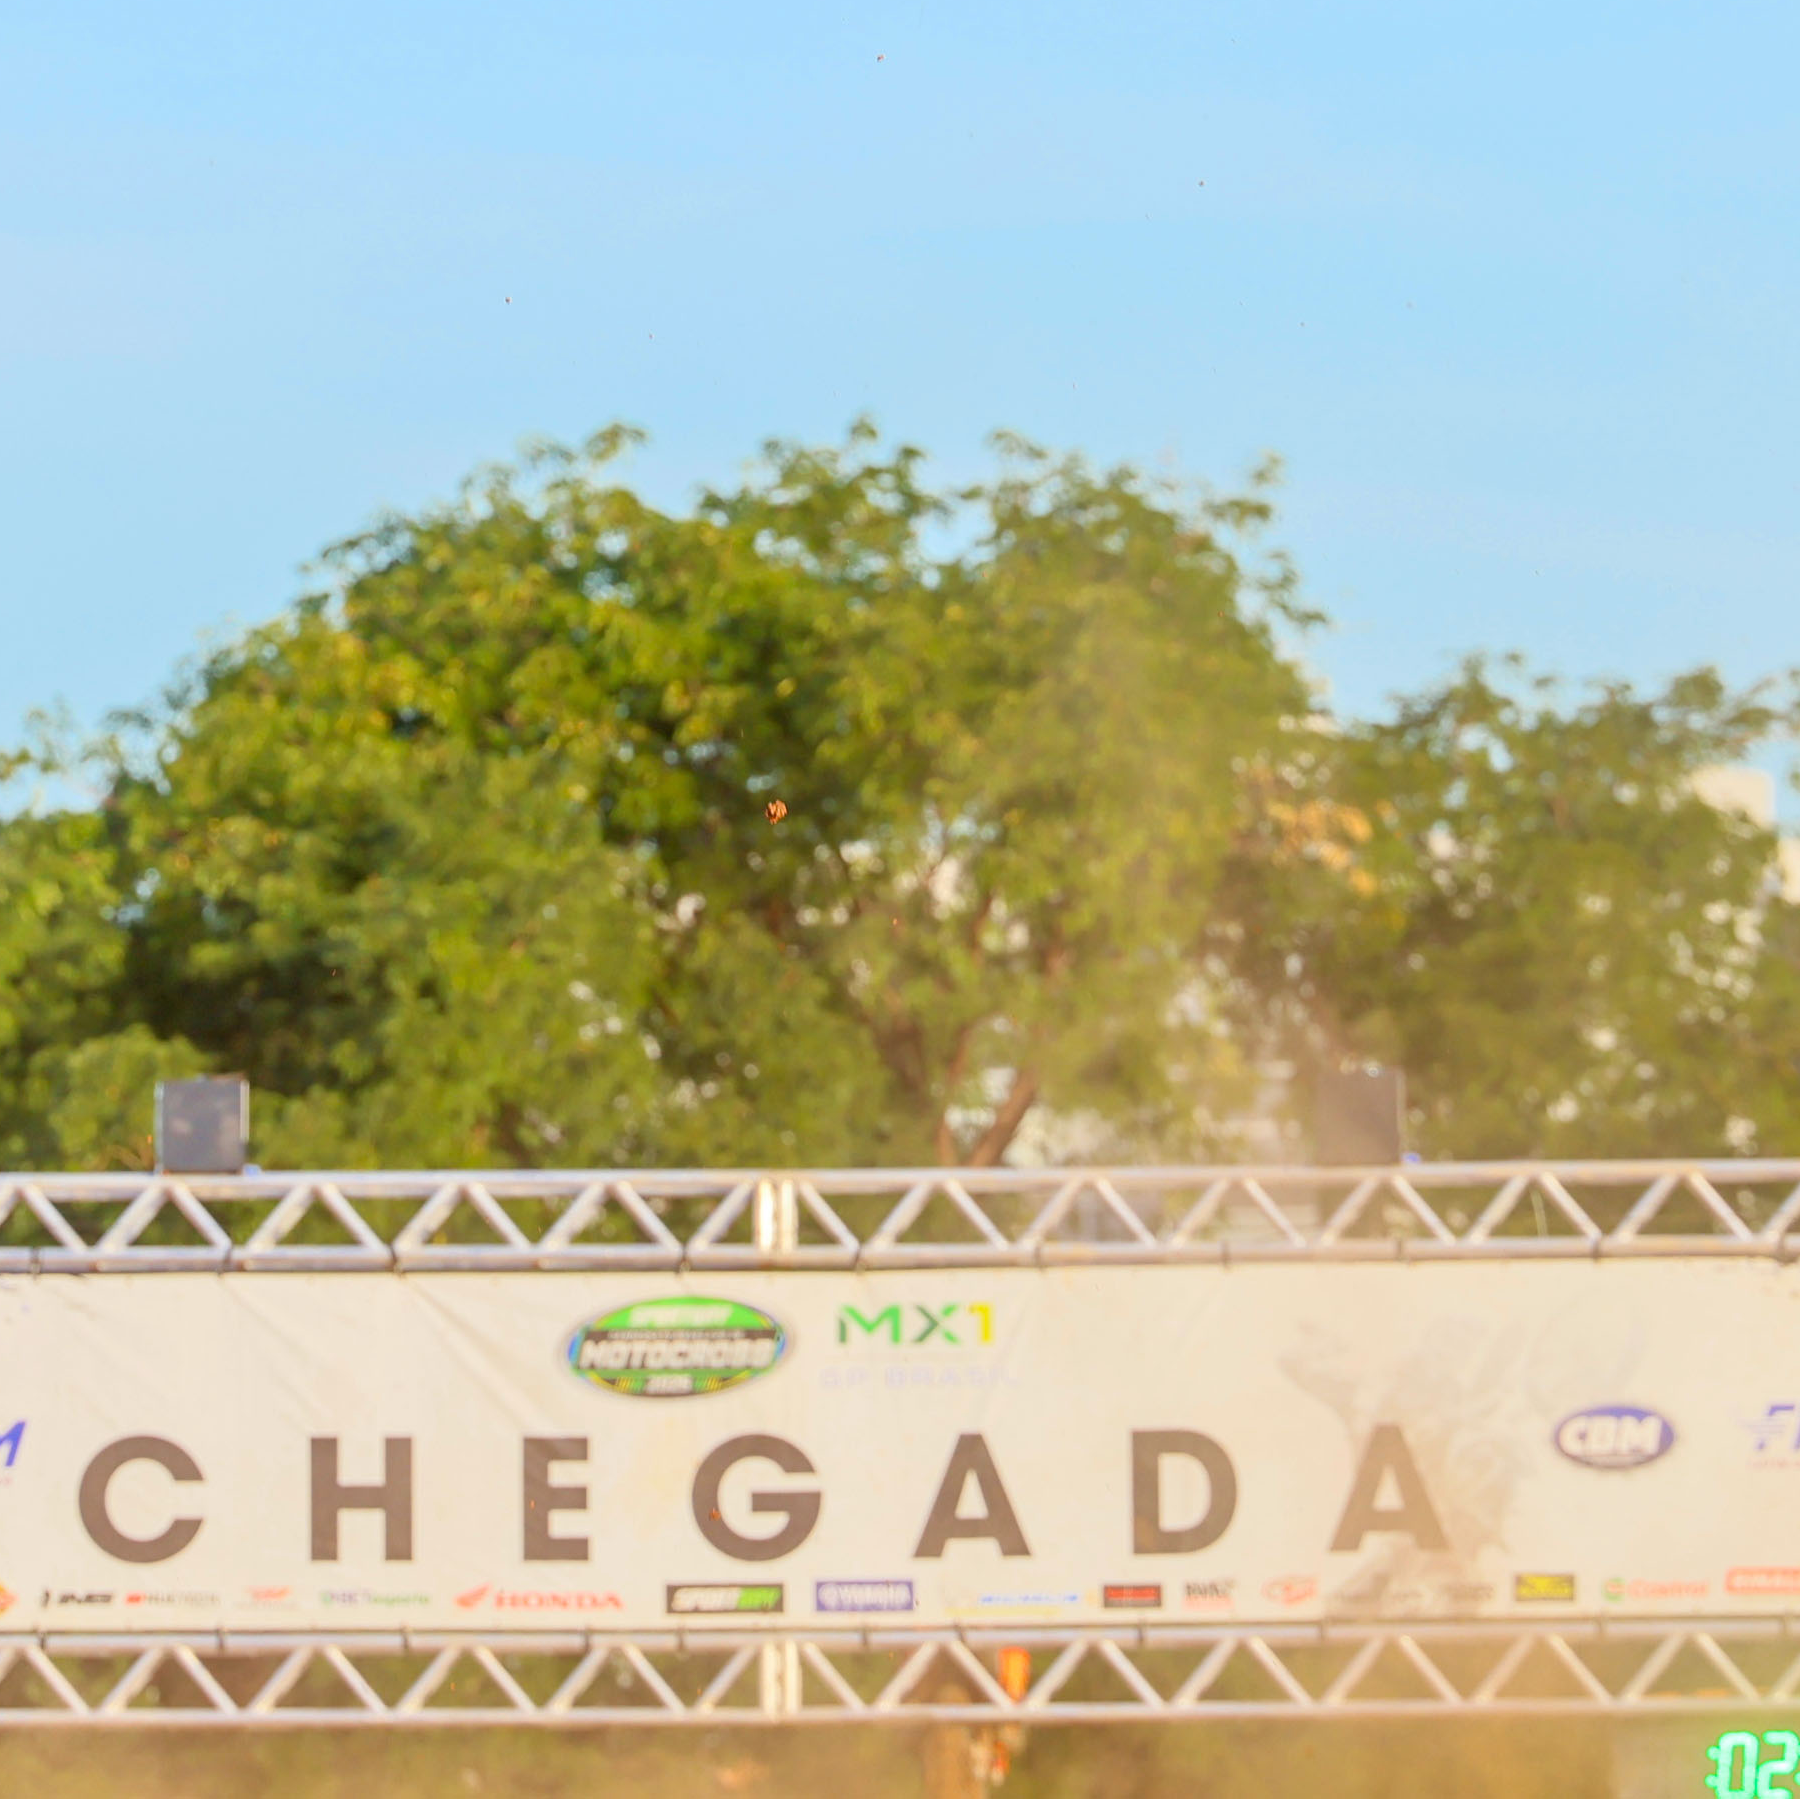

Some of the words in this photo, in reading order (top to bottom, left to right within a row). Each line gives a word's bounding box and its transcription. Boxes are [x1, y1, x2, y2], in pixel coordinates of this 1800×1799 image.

[838, 1303, 992, 1344] MX1
[578, 1339, 777, 1369] MOTOCROSS
[78, 1423, 1450, 1563] CHEGADA
[494, 1589, 623, 1611] HONDA
